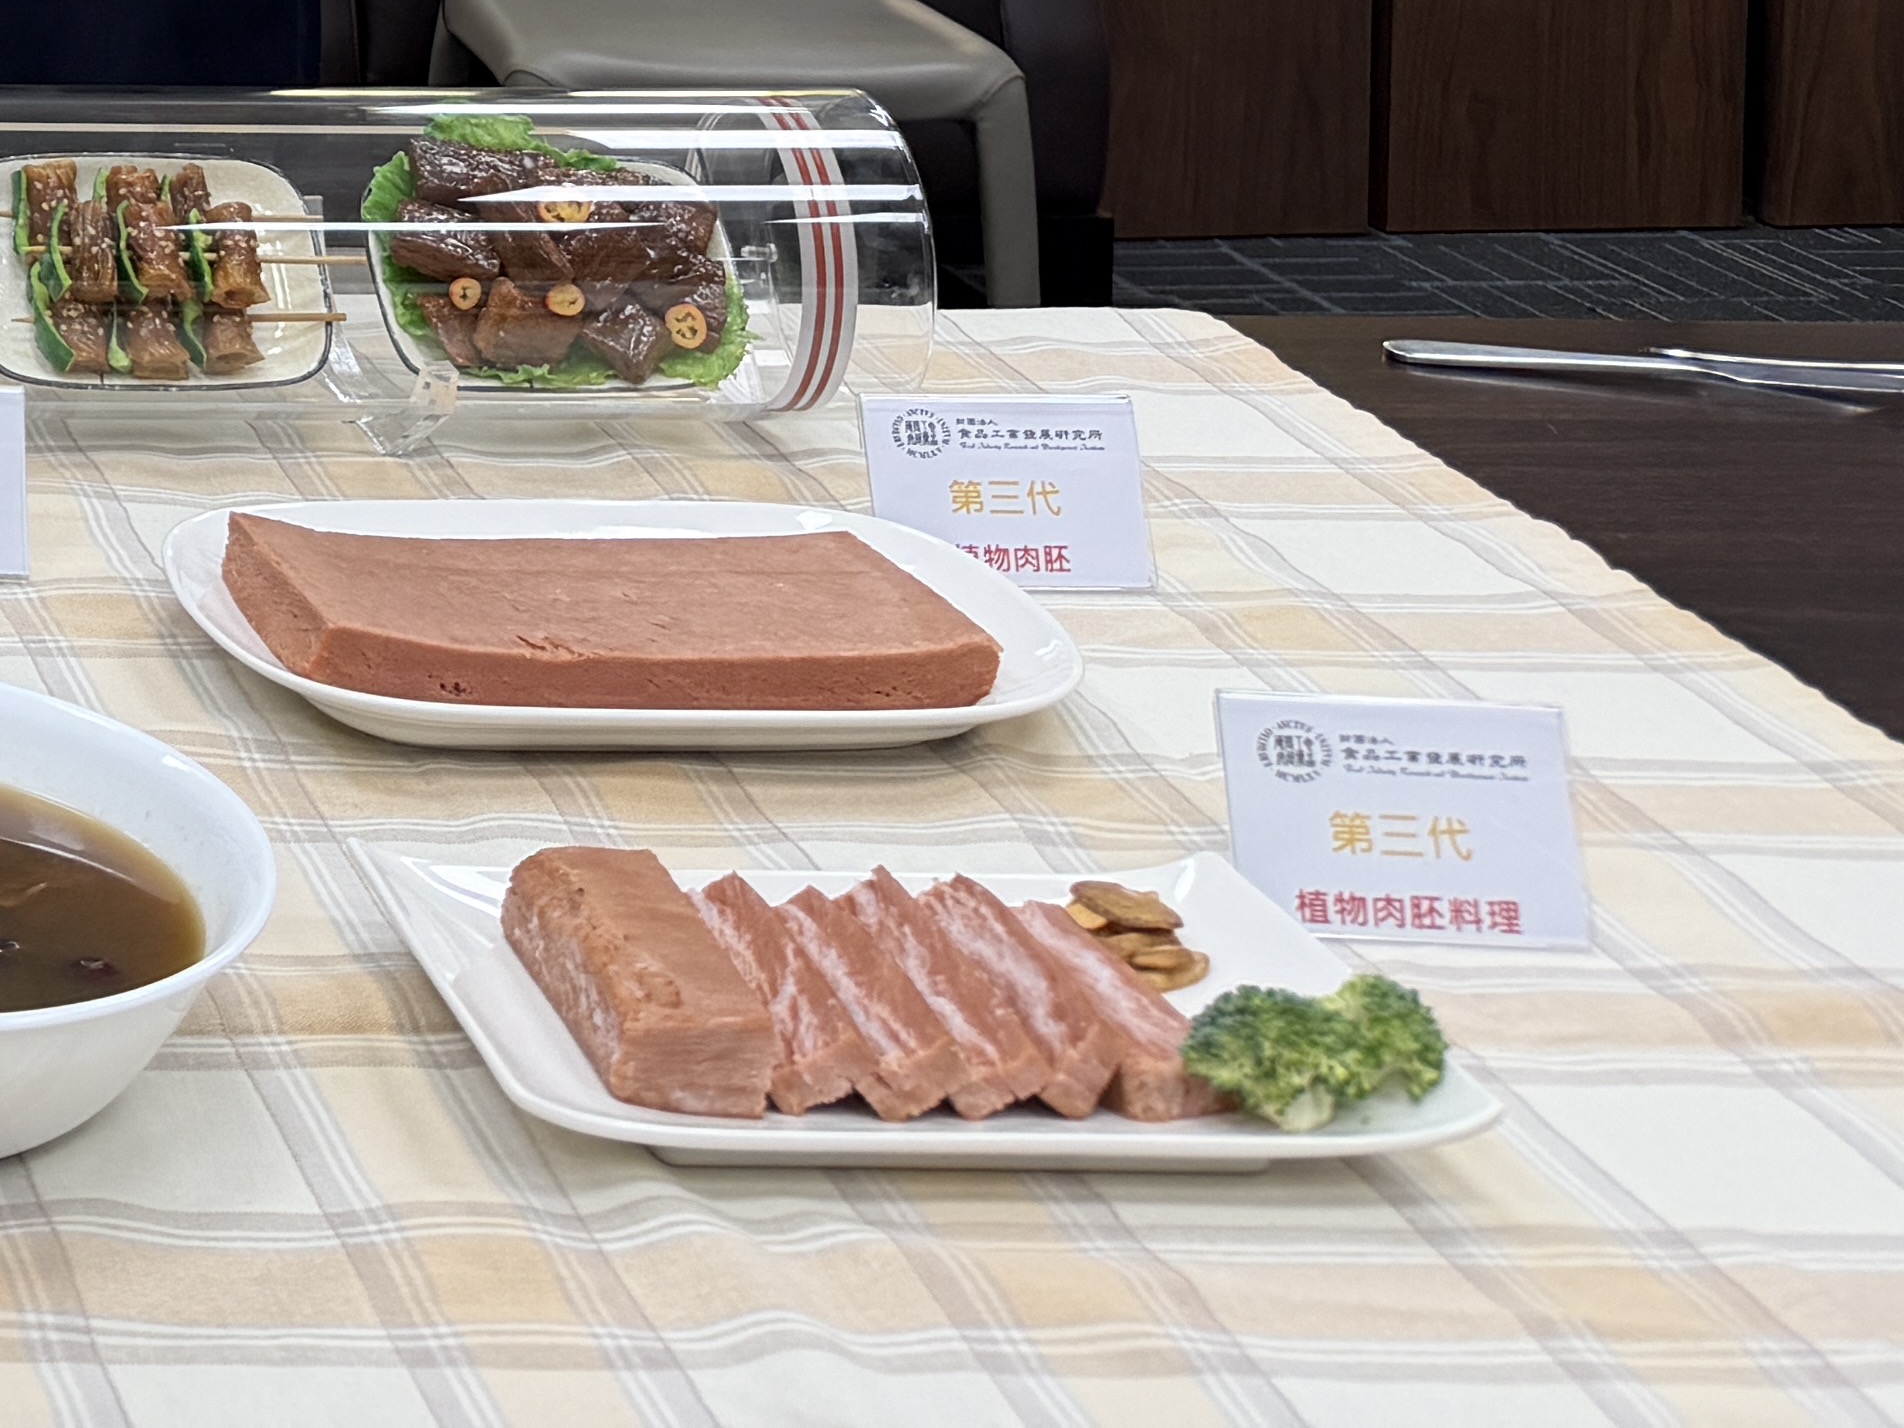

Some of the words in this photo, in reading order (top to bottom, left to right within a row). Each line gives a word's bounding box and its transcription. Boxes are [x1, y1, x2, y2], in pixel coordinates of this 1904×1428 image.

[948, 479, 1062, 516] 第三代
[1329, 810, 1473, 861] 第三代
[1295, 888, 1523, 935] 植物肉胚料理
